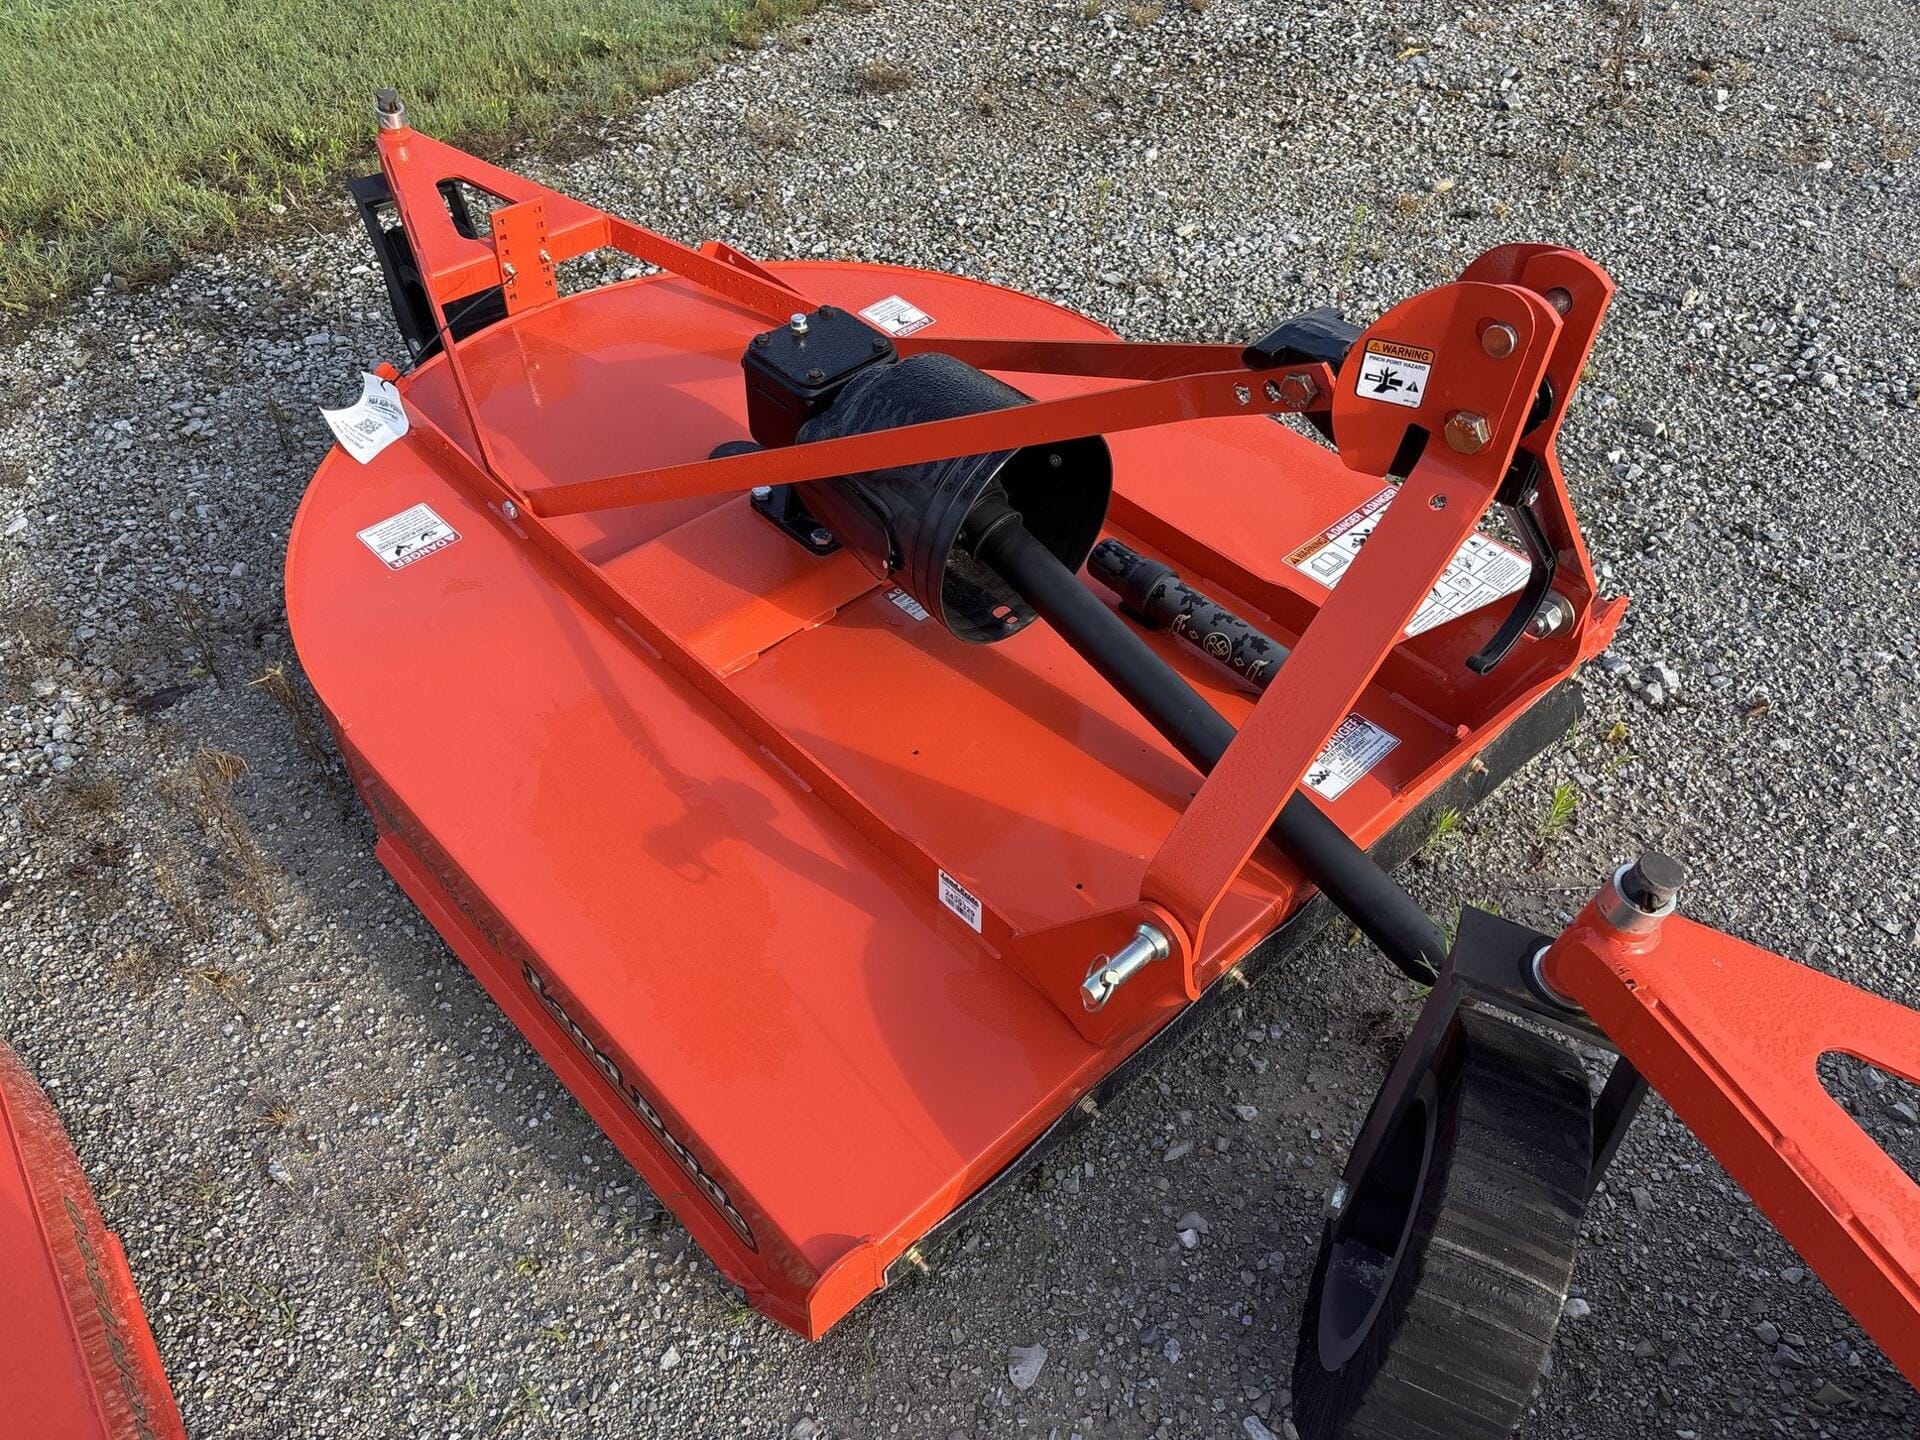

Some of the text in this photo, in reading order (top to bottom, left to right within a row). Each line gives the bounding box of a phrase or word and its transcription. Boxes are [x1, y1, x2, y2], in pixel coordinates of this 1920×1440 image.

[1369, 355, 1426, 371] PINCH POINT HAZARD
[1382, 343, 1429, 361] WARNING
[1367, 488, 1398, 512] DANGER
[1331, 512, 1365, 538] DANGER
[392, 537, 448, 568] DANGER
[1297, 537, 1328, 563] WARNING
[631, 1086, 756, 1245] Pride
